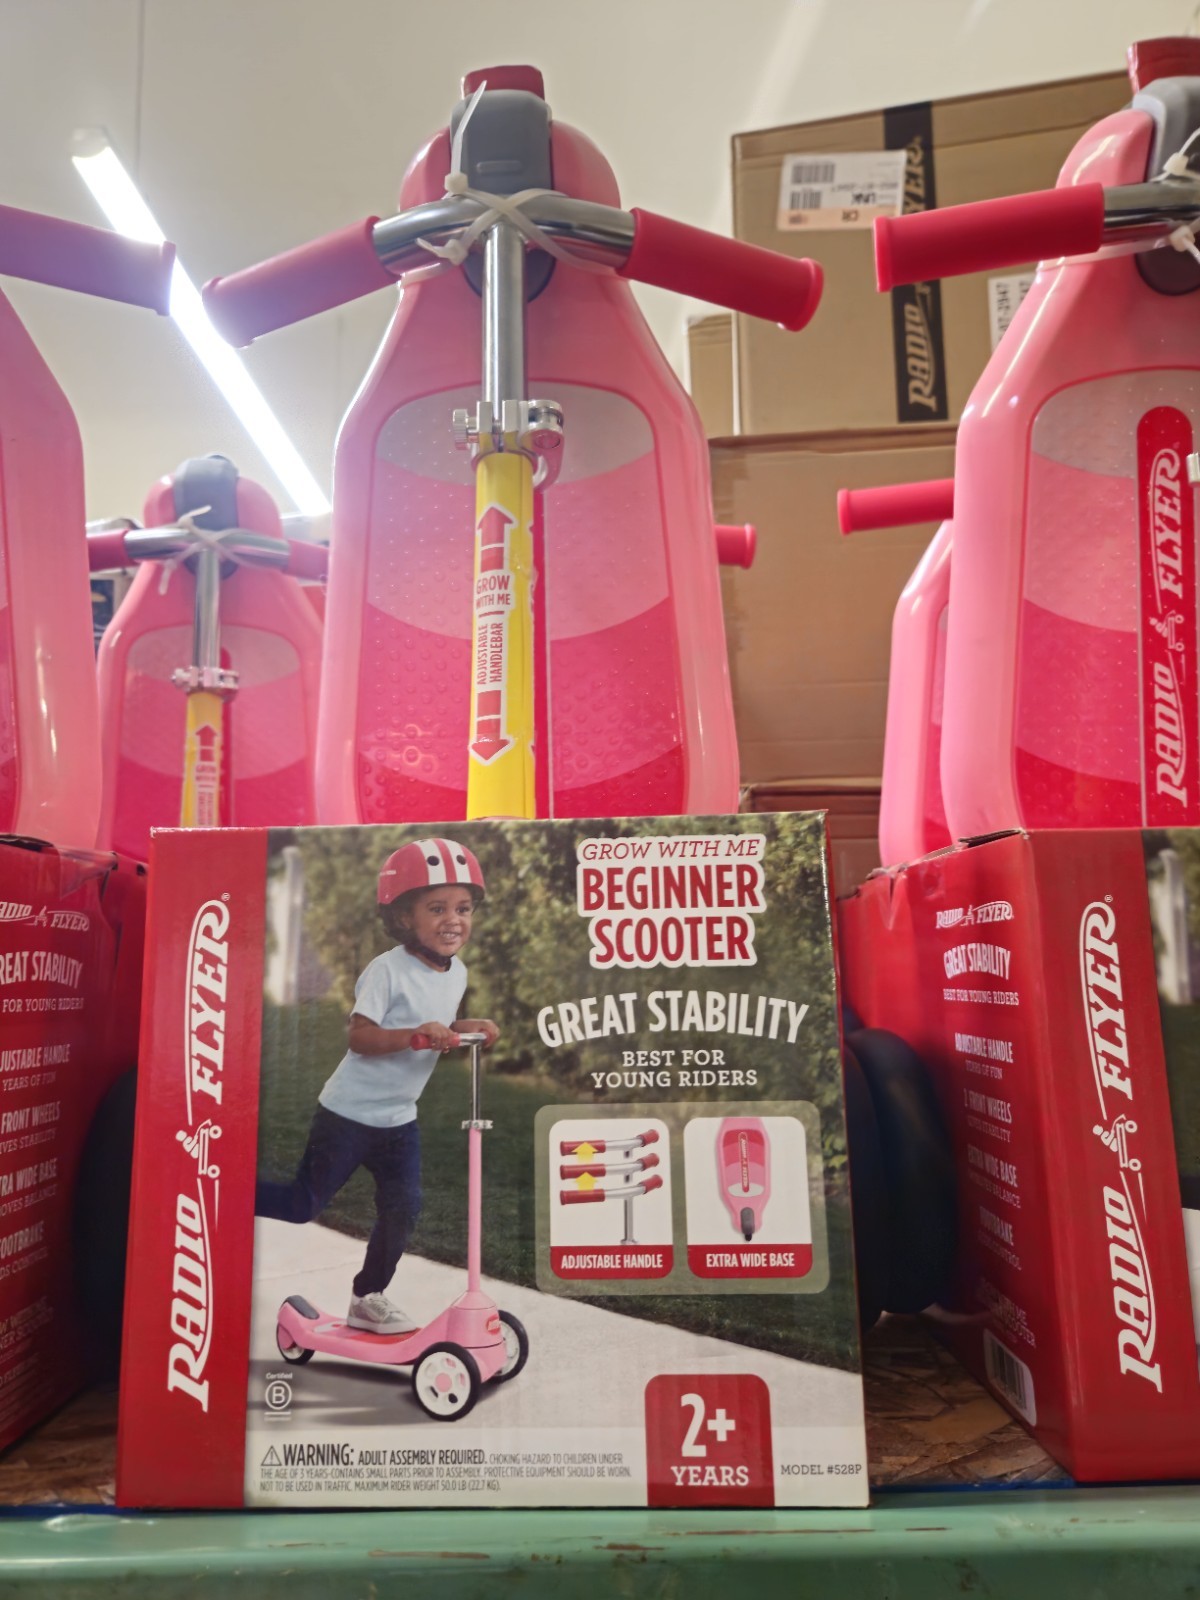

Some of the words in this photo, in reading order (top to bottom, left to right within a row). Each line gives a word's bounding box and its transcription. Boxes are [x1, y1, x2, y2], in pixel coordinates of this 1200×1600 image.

[904, 302, 938, 412] RADIO
[1150, 448, 1183, 599] FLYER
[476, 575, 510, 594] GROW
[476, 594, 495, 609] WITH
[497, 594, 511, 605] ME
[477, 624, 488, 685] ADJUSTABLE
[490, 623, 503, 683] HANDLEBAR
[1154, 662, 1187, 808] RADIO
[583, 843, 650, 860] GROW
[658, 840, 719, 858] WITH
[725, 839, 760, 856] ME
[583, 864, 760, 911] BEGINNER
[50, 911, 90, 932] FLYER
[936, 908, 963, 929] RADIO
[976, 901, 1013, 924] FLYER
[595, 916, 750, 963] SCOOTER
[31, 950, 83, 989] STABILITY
[944, 945, 967, 979] GREAT
[967, 943, 1011, 980] STABILITY
[2, 999, 23, 1012] FOR
[26, 998, 57, 1012] YOUNG
[993, 991, 1020, 1006] RIDERS
[537, 992, 637, 1047] GREAT
[647, 990, 809, 1043] STABILITY
[622, 1051, 675, 1067] BEST
[682, 1049, 726, 1066] FOR
[987, 1038, 1014, 1063] HANDLE
[3, 1076, 28, 1091] YEARS
[30, 1074, 41, 1086] OF
[591, 1071, 671, 1088] YOUNG
[678, 1070, 757, 1087] RIDERS
[1, 1108, 31, 1134] FRONT
[986, 1096, 1012, 1124] WHEELS
[16, 1164, 38, 1191] WIDE
[1000, 1160, 1018, 1188] BASE
[561, 1254, 621, 1269] ADJUSTABLE
[623, 1254, 663, 1268] HANDLE
[706, 1253, 738, 1267] EXTRA
[740, 1253, 768, 1267] WIDE
[769, 1253, 795, 1267] BASE
[1103, 1186, 1162, 1393] RADIO
[168, 1193, 210, 1413] RADIO
[272, 1386, 285, 1404] B
[681, 1393, 736, 1457] 2+
[283, 1443, 354, 1466] WARNING:
[358, 1450, 388, 1465] ADULT
[389, 1450, 436, 1465] ASSEMBLY
[439, 1449, 487, 1464] REQUIRED.
[489, 1453, 520, 1464] CHOKING
[522, 1453, 551, 1464] HAZARD
[553, 1453, 561, 1464] TO
[563, 1453, 597, 1464] CHILDREN
[599, 1453, 623, 1464] UNDER
[261, 1468, 273, 1479] THE
[275, 1468, 288, 1479] AGE
[290, 1468, 298, 1479] OF
[300, 1468, 305, 1479] 3
[366, 1468, 388, 1479] SMALL
[389, 1468, 410, 1479] PARTS
[413, 1468, 433, 1479] PRIOR
[435, 1468, 444, 1479] TO
[484, 1467, 524, 1478] PROTECTIVE
[526, 1467, 565, 1478] EQUIPMENT
[567, 1467, 595, 1478] SHOULD
[597, 1467, 605, 1478] BE
[671, 1466, 749, 1486] YEARS
[781, 1465, 824, 1475] MODEL
[827, 1464, 862, 1475] #528P
[260, 1481, 273, 1491] NOT
[275, 1481, 284, 1491] TO
[285, 1481, 294, 1491] BE
[296, 1481, 313, 1491] USED
[315, 1481, 322, 1491] IN
[354, 1481, 389, 1491] MAXIMUM
[391, 1481, 410, 1491] RIDER
[413, 1481, 440, 1491] WEIGHT
